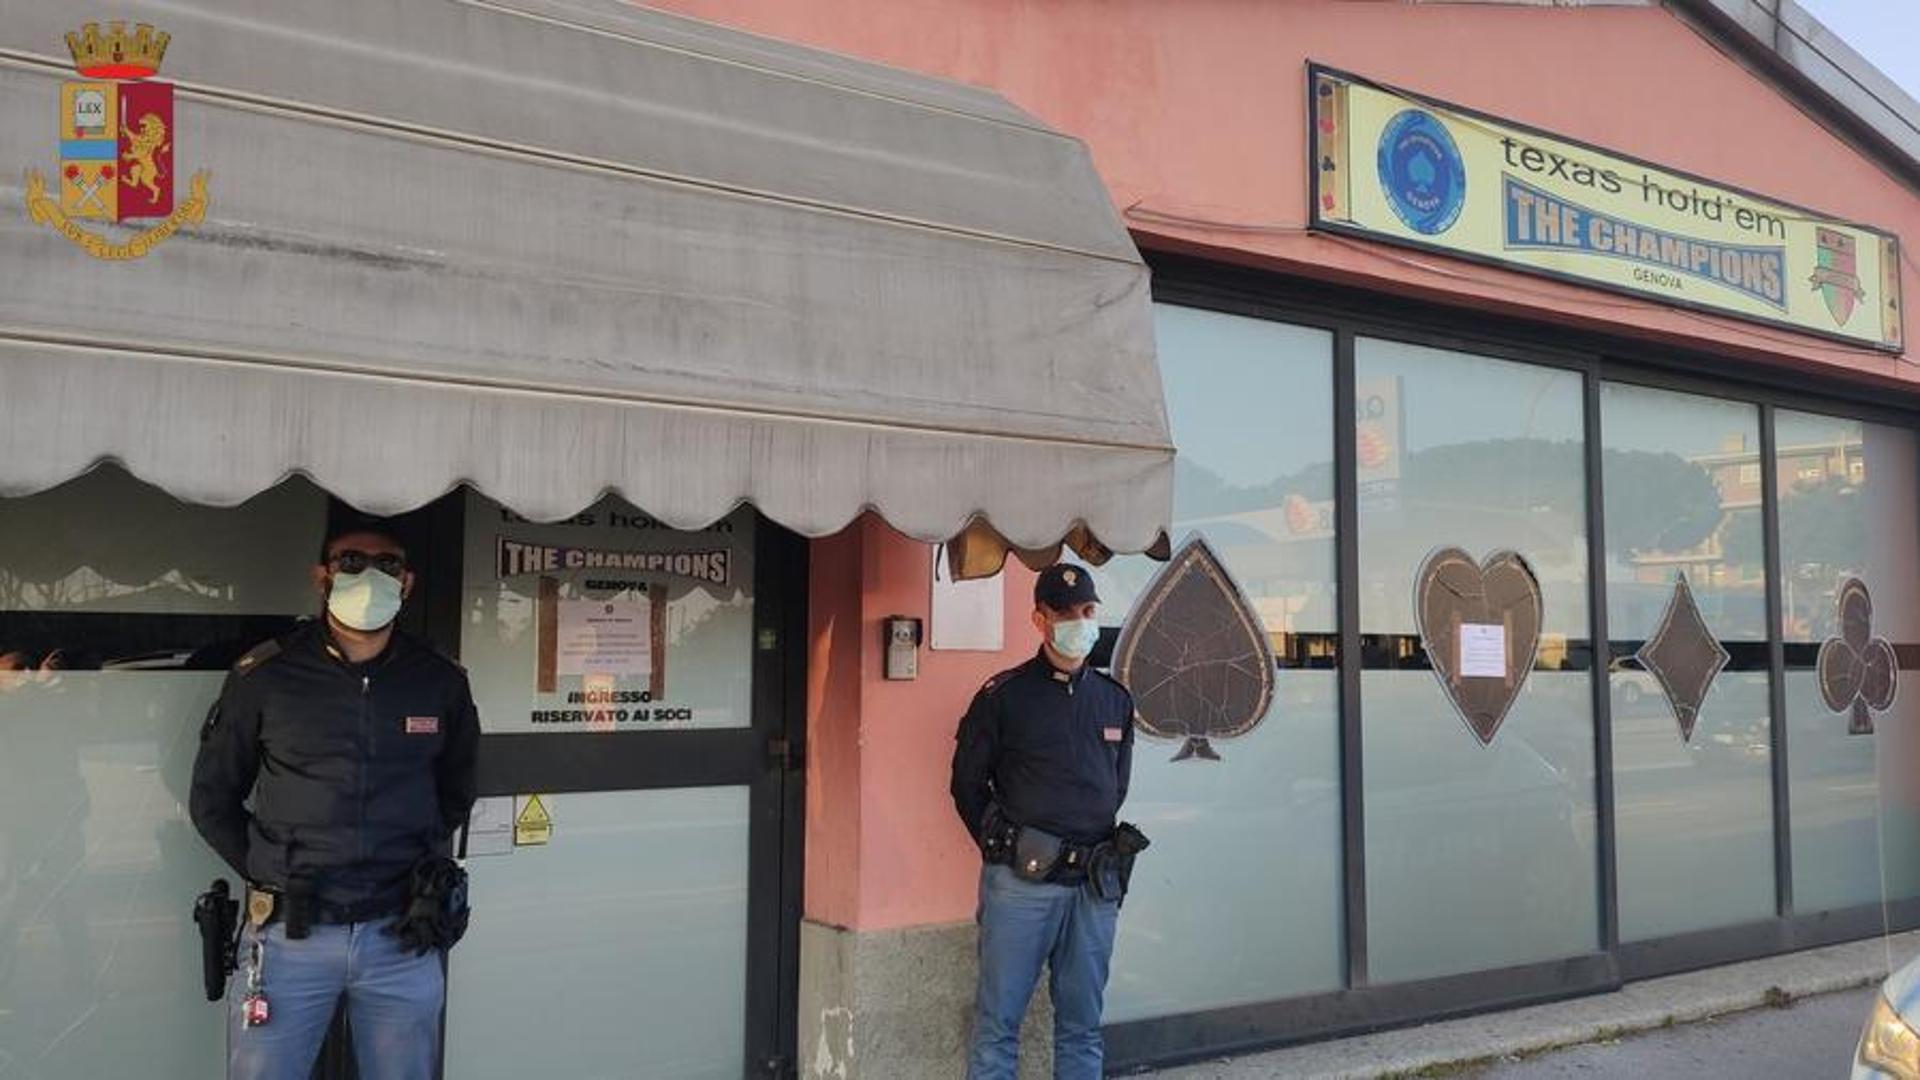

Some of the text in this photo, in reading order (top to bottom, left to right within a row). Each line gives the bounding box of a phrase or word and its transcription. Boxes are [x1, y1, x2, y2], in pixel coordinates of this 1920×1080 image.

[1500, 136, 1622, 194] texas
[1642, 174, 1786, 239] hold'em
[1511, 186, 1580, 245] THE
[1589, 216, 1782, 299] CHAMPIONS
[1633, 267, 1683, 290] GENOVA
[504, 541, 727, 583] THE CHAMPIONS
[585, 579, 648, 592] GENOVA
[567, 690, 653, 704] INGRESSO
[531, 708, 693, 723] RISERVATO AI SOCI
